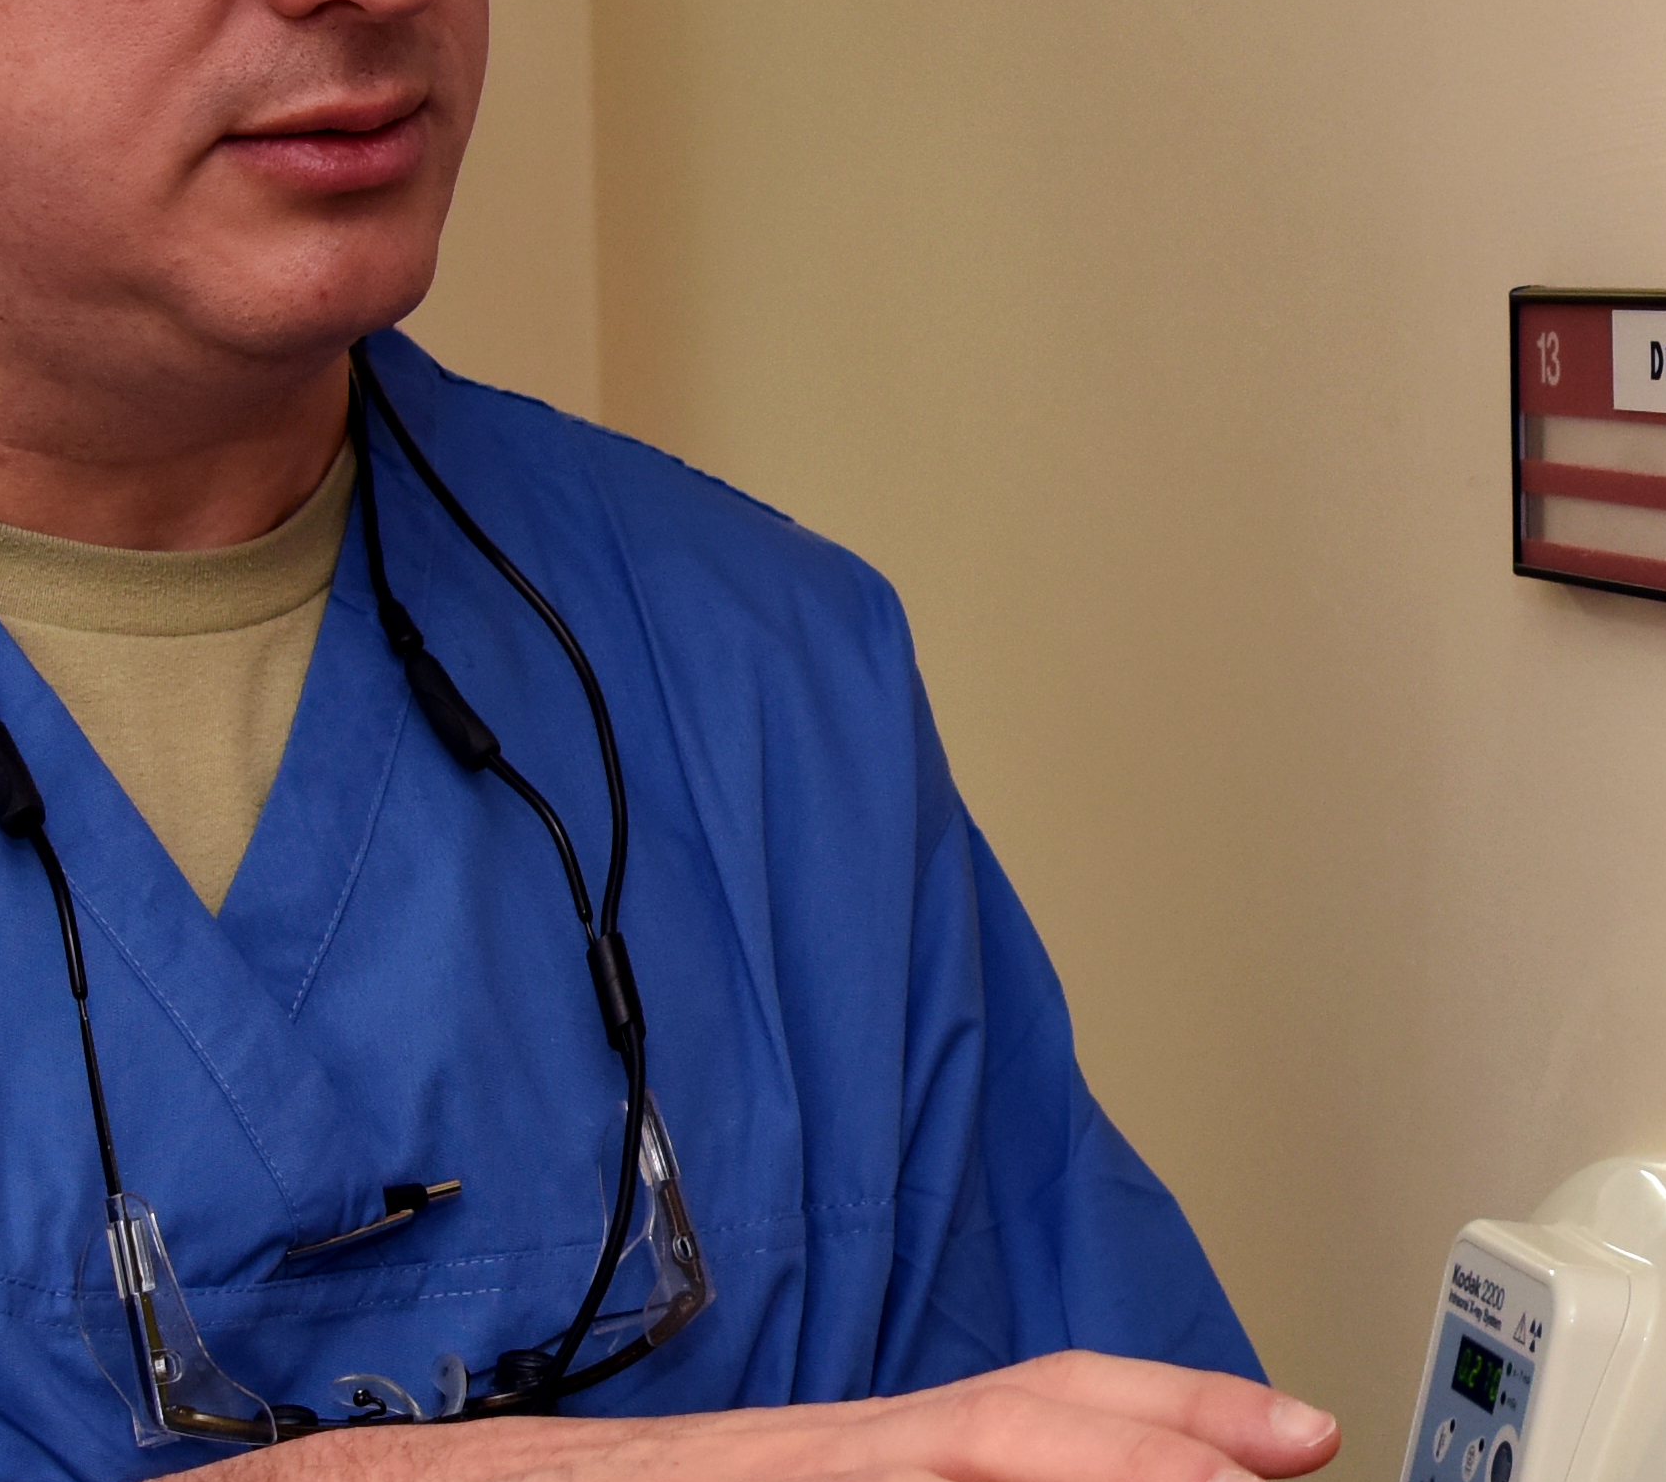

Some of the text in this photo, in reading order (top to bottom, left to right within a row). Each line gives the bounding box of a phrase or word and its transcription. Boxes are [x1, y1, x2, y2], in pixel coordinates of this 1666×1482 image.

[1536, 331, 1561, 386] 13
[1452, 1263, 1505, 1311] Kodak 2200
